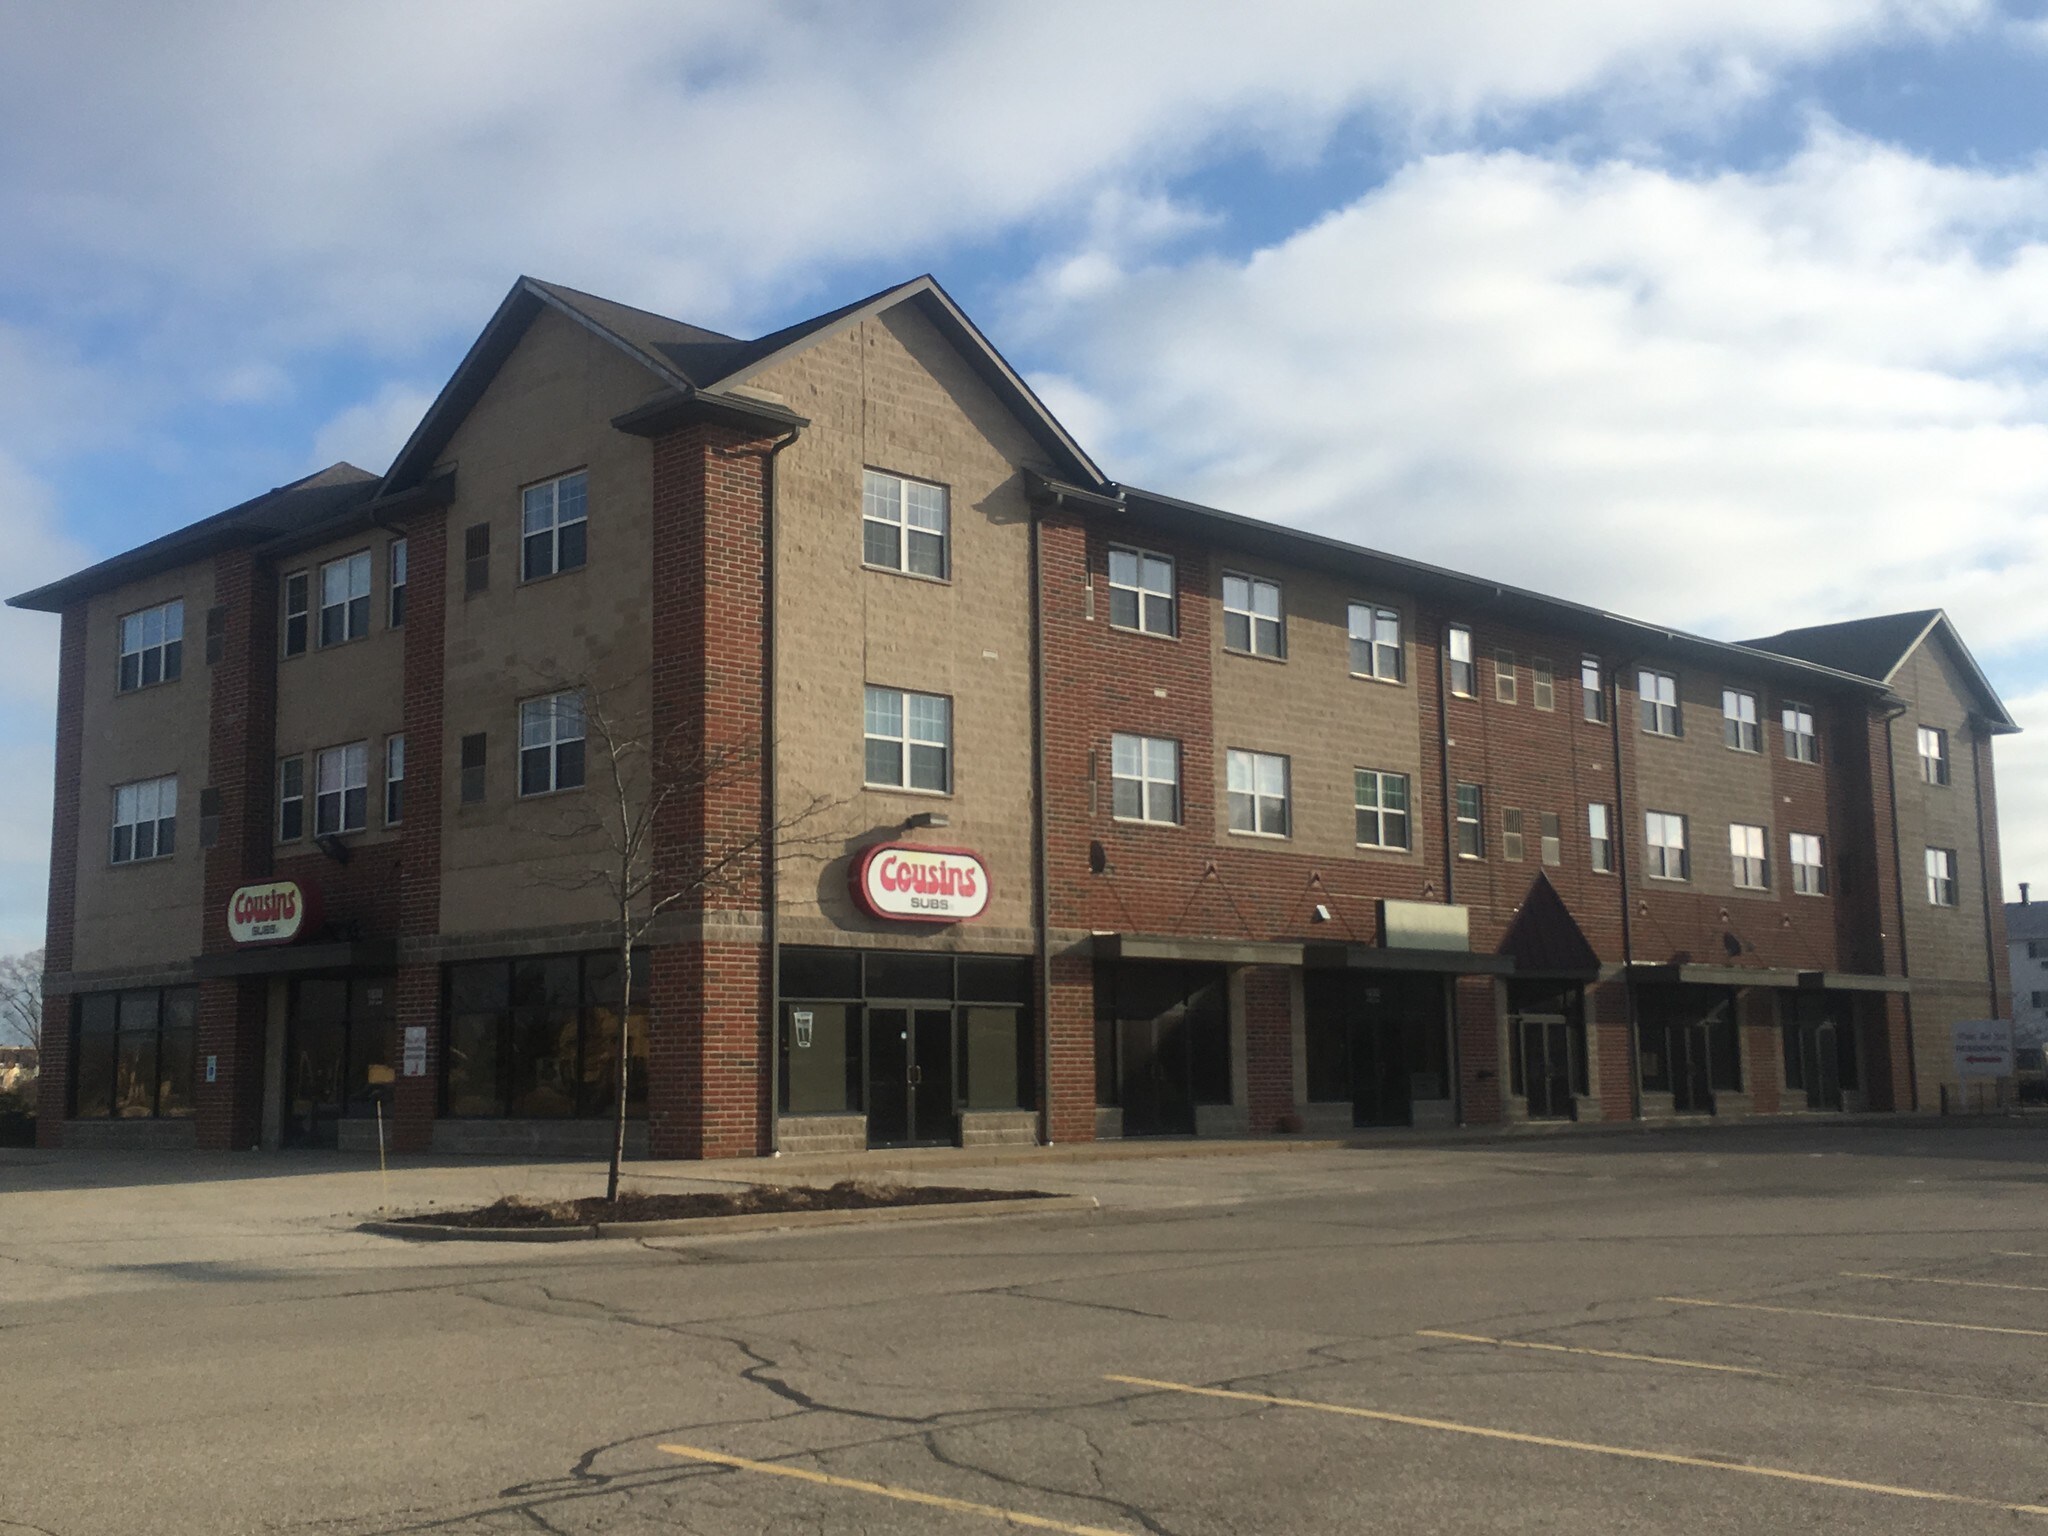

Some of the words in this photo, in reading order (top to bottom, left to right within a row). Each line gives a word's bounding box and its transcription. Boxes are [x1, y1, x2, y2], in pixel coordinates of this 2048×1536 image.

[880, 855, 976, 897] Cousins
[234, 889, 296, 924] Cousins
[911, 897, 949, 910] SUBS
[252, 925, 276, 936] SUBS
